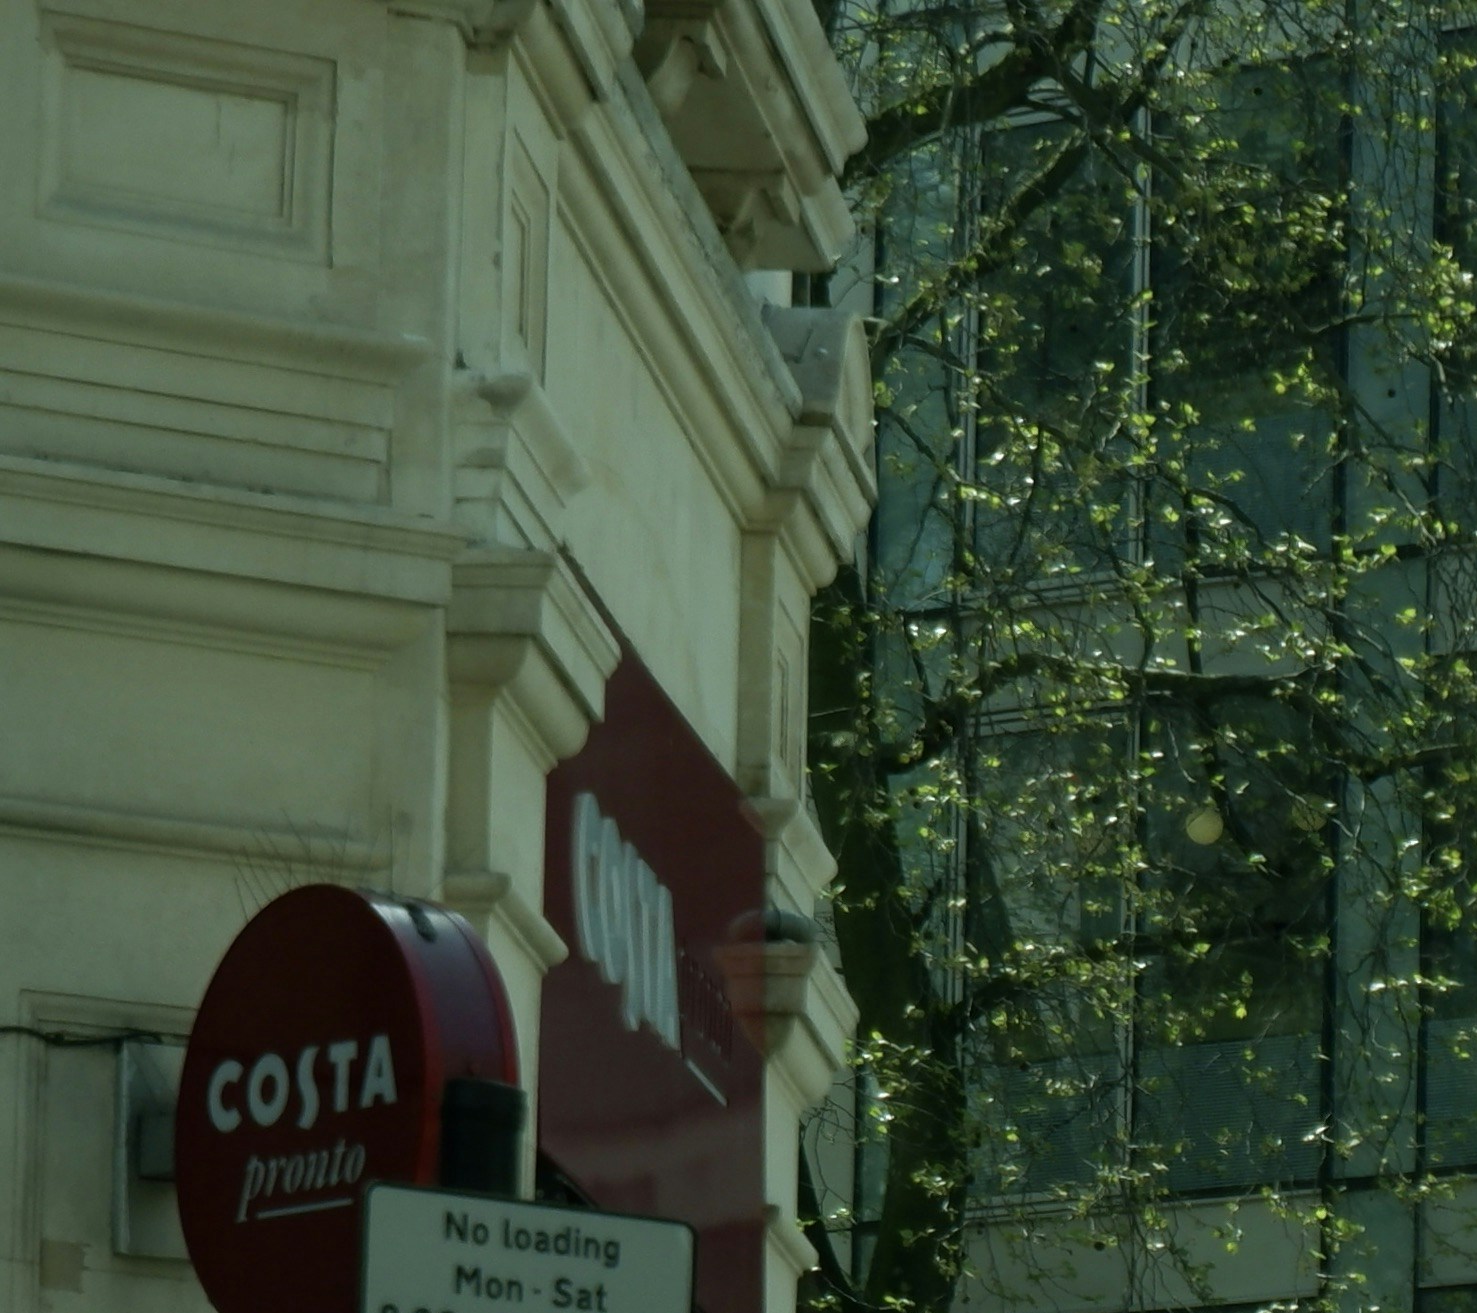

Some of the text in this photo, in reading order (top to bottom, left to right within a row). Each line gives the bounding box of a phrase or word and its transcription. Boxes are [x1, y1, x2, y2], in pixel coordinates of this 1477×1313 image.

[207, 1032, 398, 1133] COSTA
[236, 1138, 366, 1223] pronto
[443, 1210, 621, 1268] No loading
[453, 1264, 524, 1304] Mon
[552, 1277, 608, 1313] Sat
